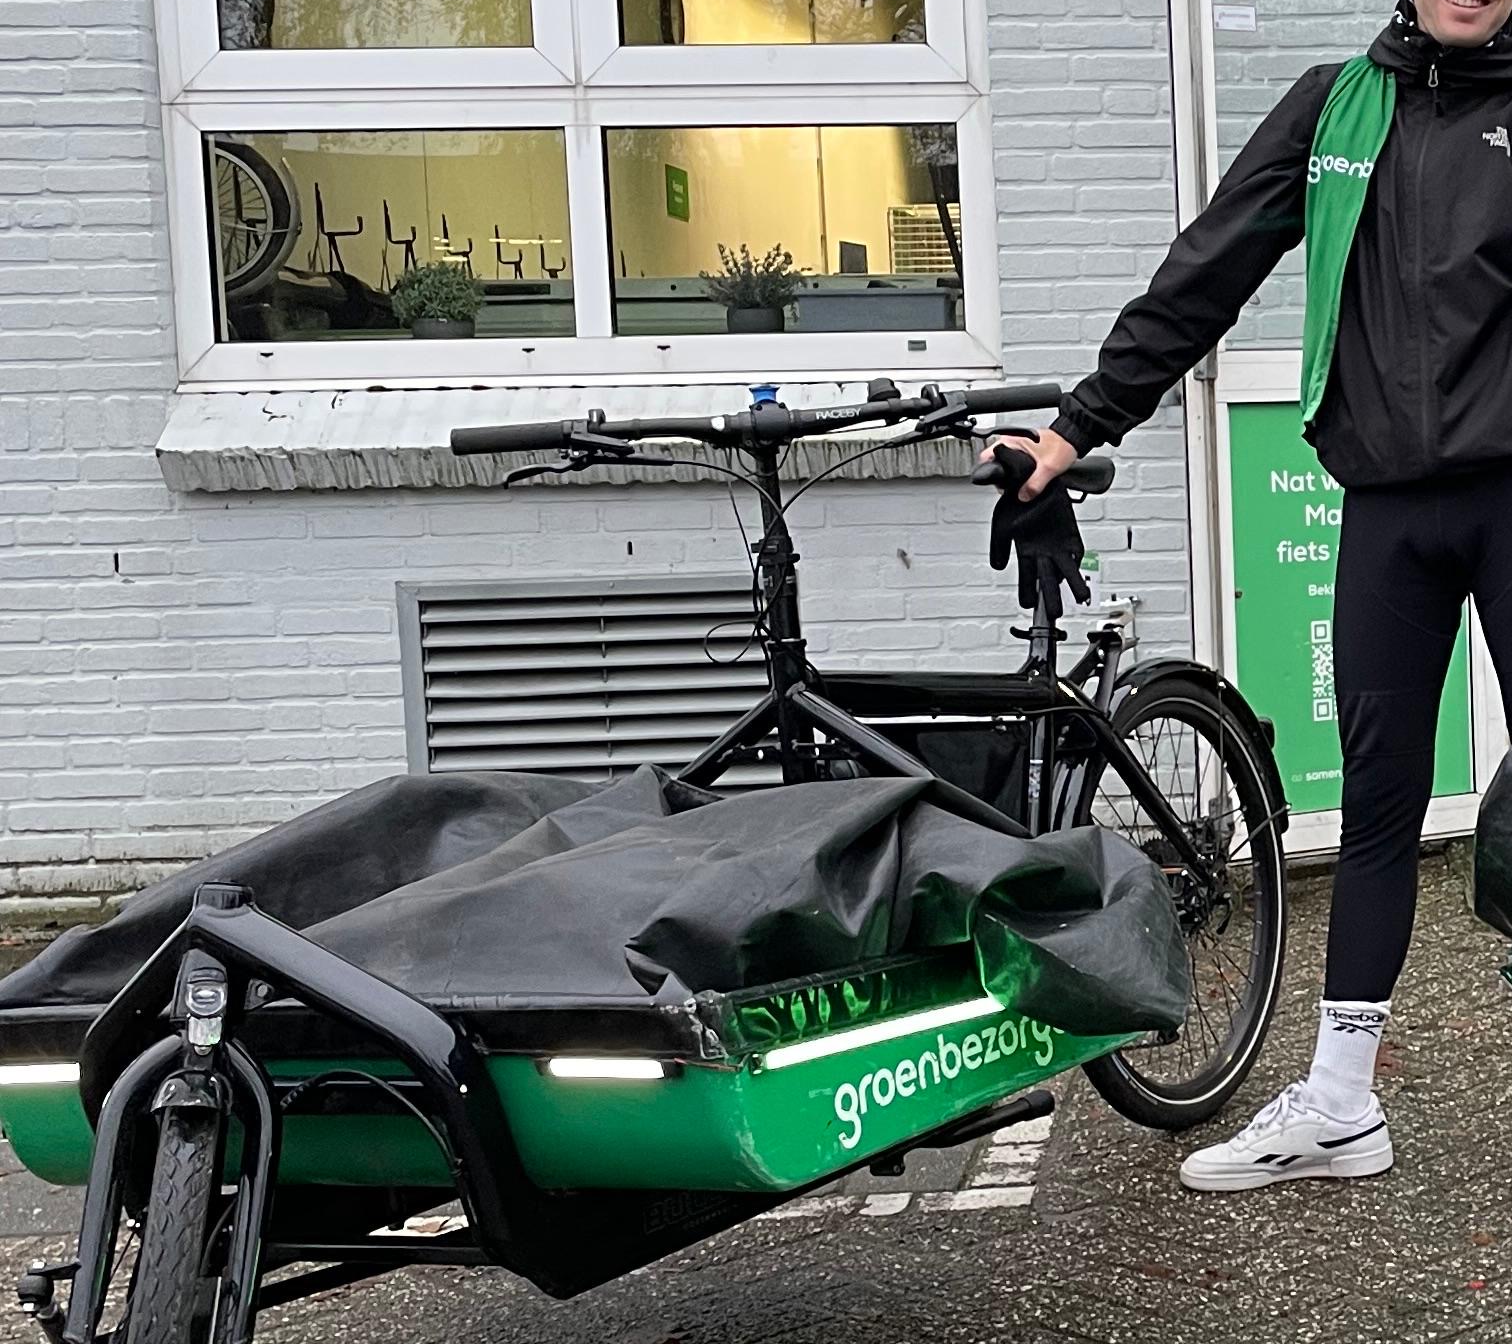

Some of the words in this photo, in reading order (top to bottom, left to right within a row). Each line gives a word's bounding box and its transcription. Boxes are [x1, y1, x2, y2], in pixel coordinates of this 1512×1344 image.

[815, 407, 862, 420] RACEBY
[1270, 469, 1317, 493] Nat
[1276, 540, 1331, 564] fiets
[1326, 1008, 1385, 1023] Reebo
[834, 1015, 1065, 1150] groenbezorg
